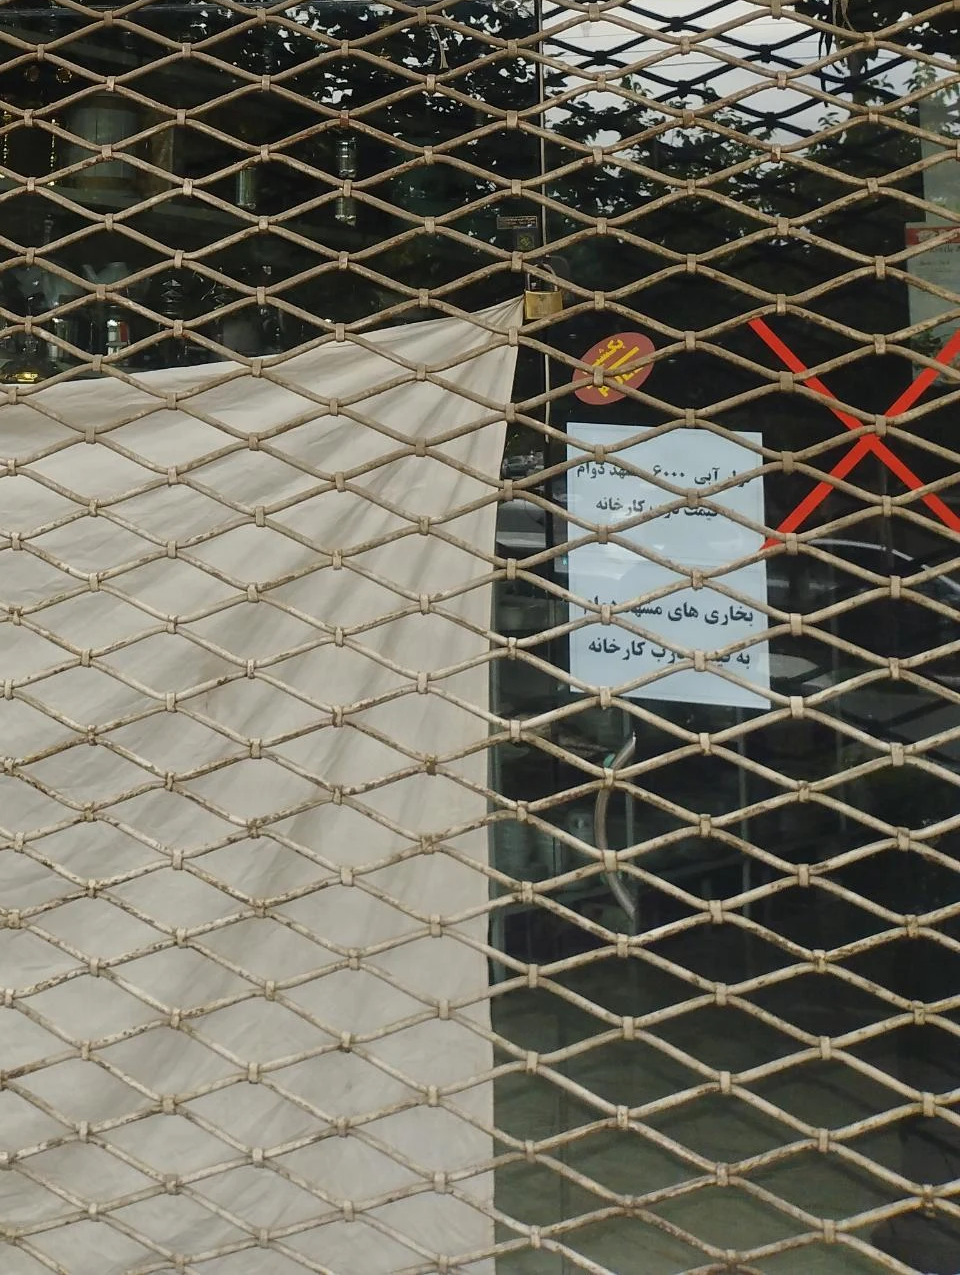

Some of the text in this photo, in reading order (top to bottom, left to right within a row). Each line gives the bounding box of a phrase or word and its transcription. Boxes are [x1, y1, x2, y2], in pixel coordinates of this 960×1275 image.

[582, 339, 626, 375] بکش
[667, 601, 699, 622] های
[704, 604, 754, 626] بخاری
[588, 636, 646, 661] کارخانه
